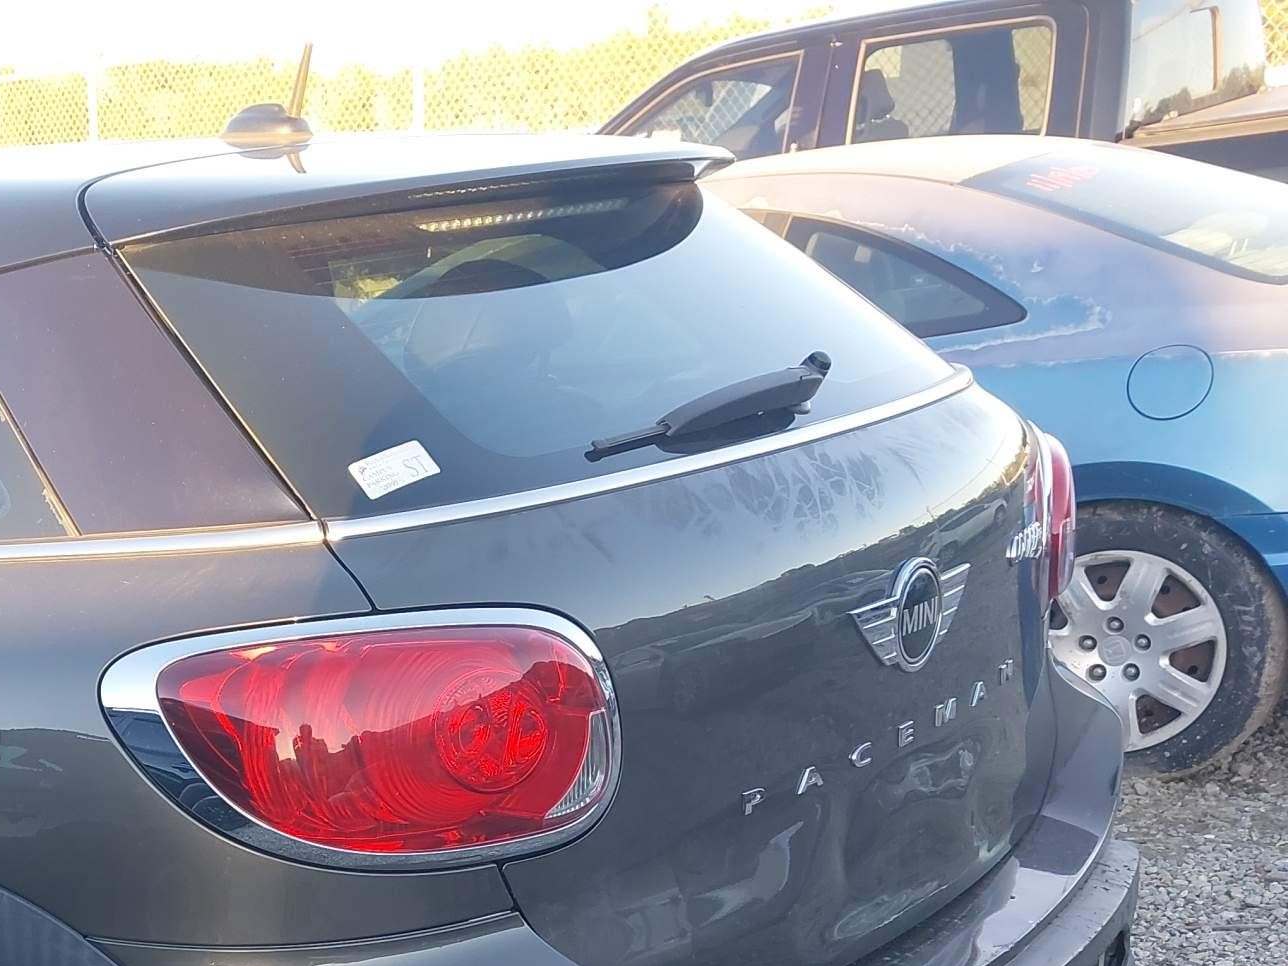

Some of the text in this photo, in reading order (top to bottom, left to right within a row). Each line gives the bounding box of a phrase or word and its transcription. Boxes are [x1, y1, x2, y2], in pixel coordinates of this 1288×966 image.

[402, 455, 430, 478] ST
[901, 596, 939, 637] MINI
[740, 658, 1015, 816] PACEMAN
